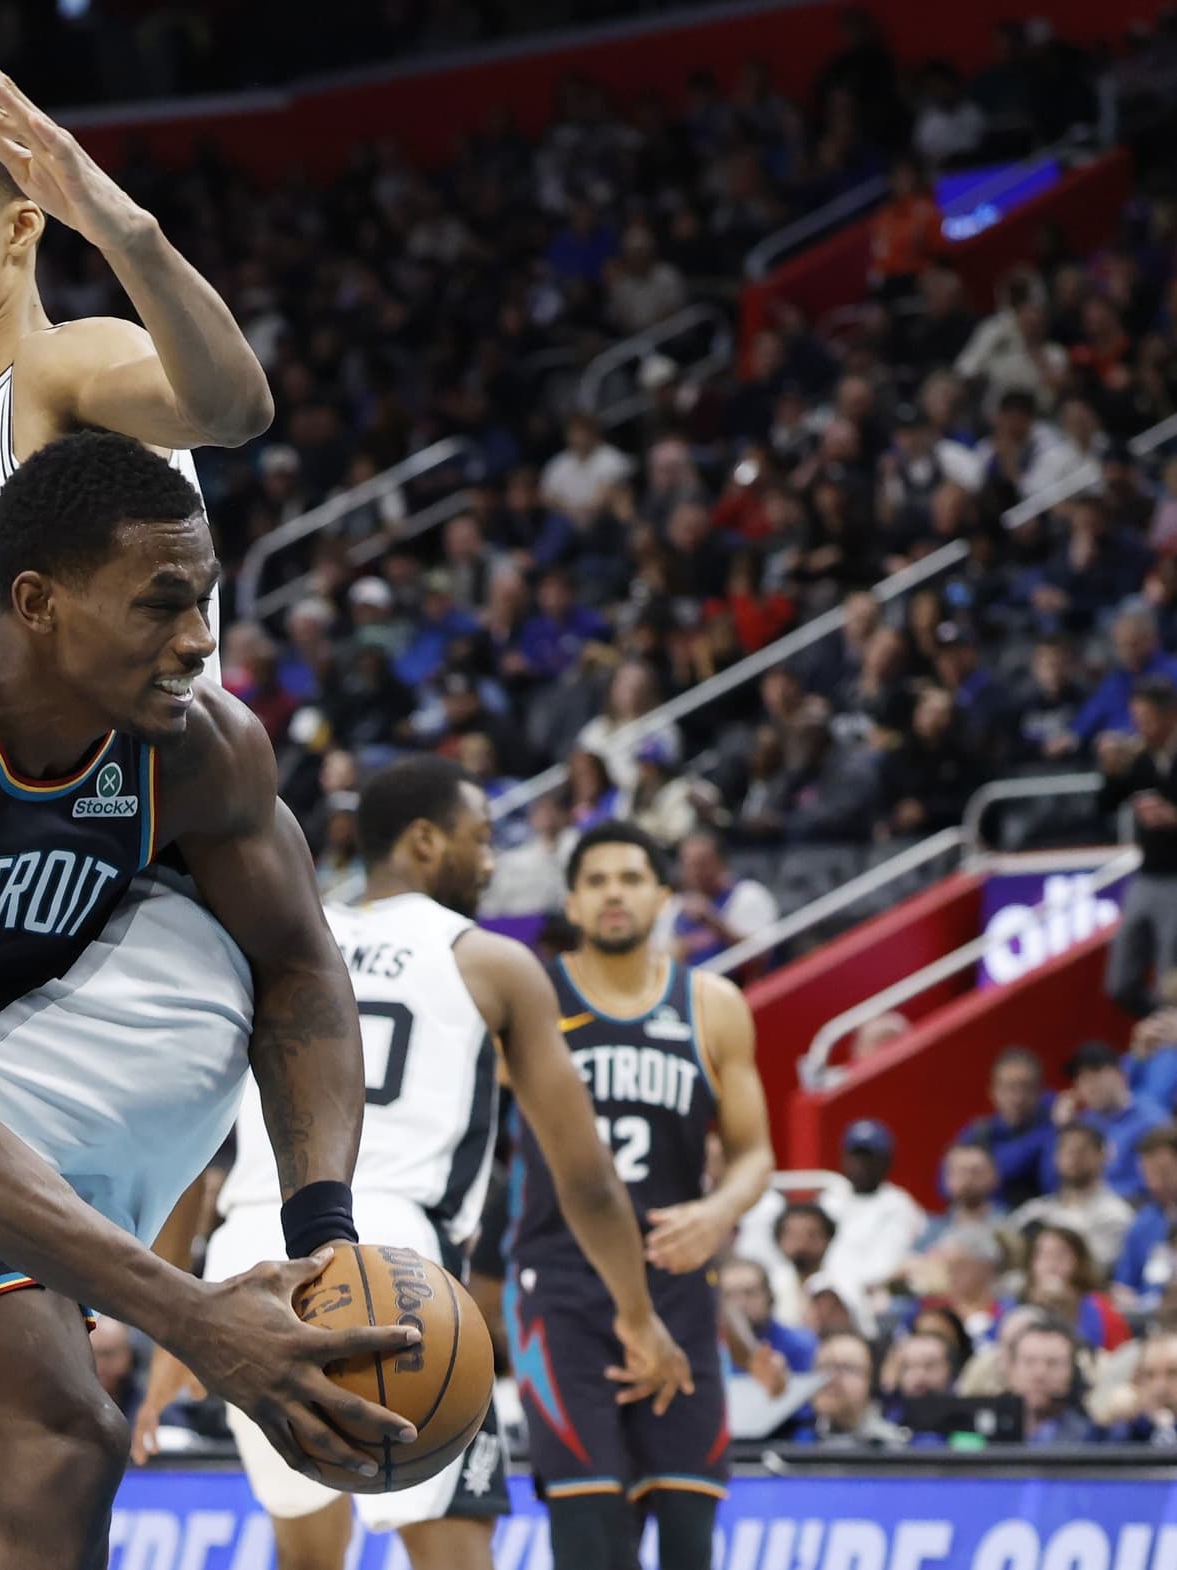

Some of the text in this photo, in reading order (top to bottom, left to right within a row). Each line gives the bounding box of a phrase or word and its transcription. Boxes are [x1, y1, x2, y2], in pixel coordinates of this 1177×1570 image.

[75, 799, 136, 814] StockX
[338, 943, 414, 979] NES
[571, 1044, 699, 1117] ETROIT
